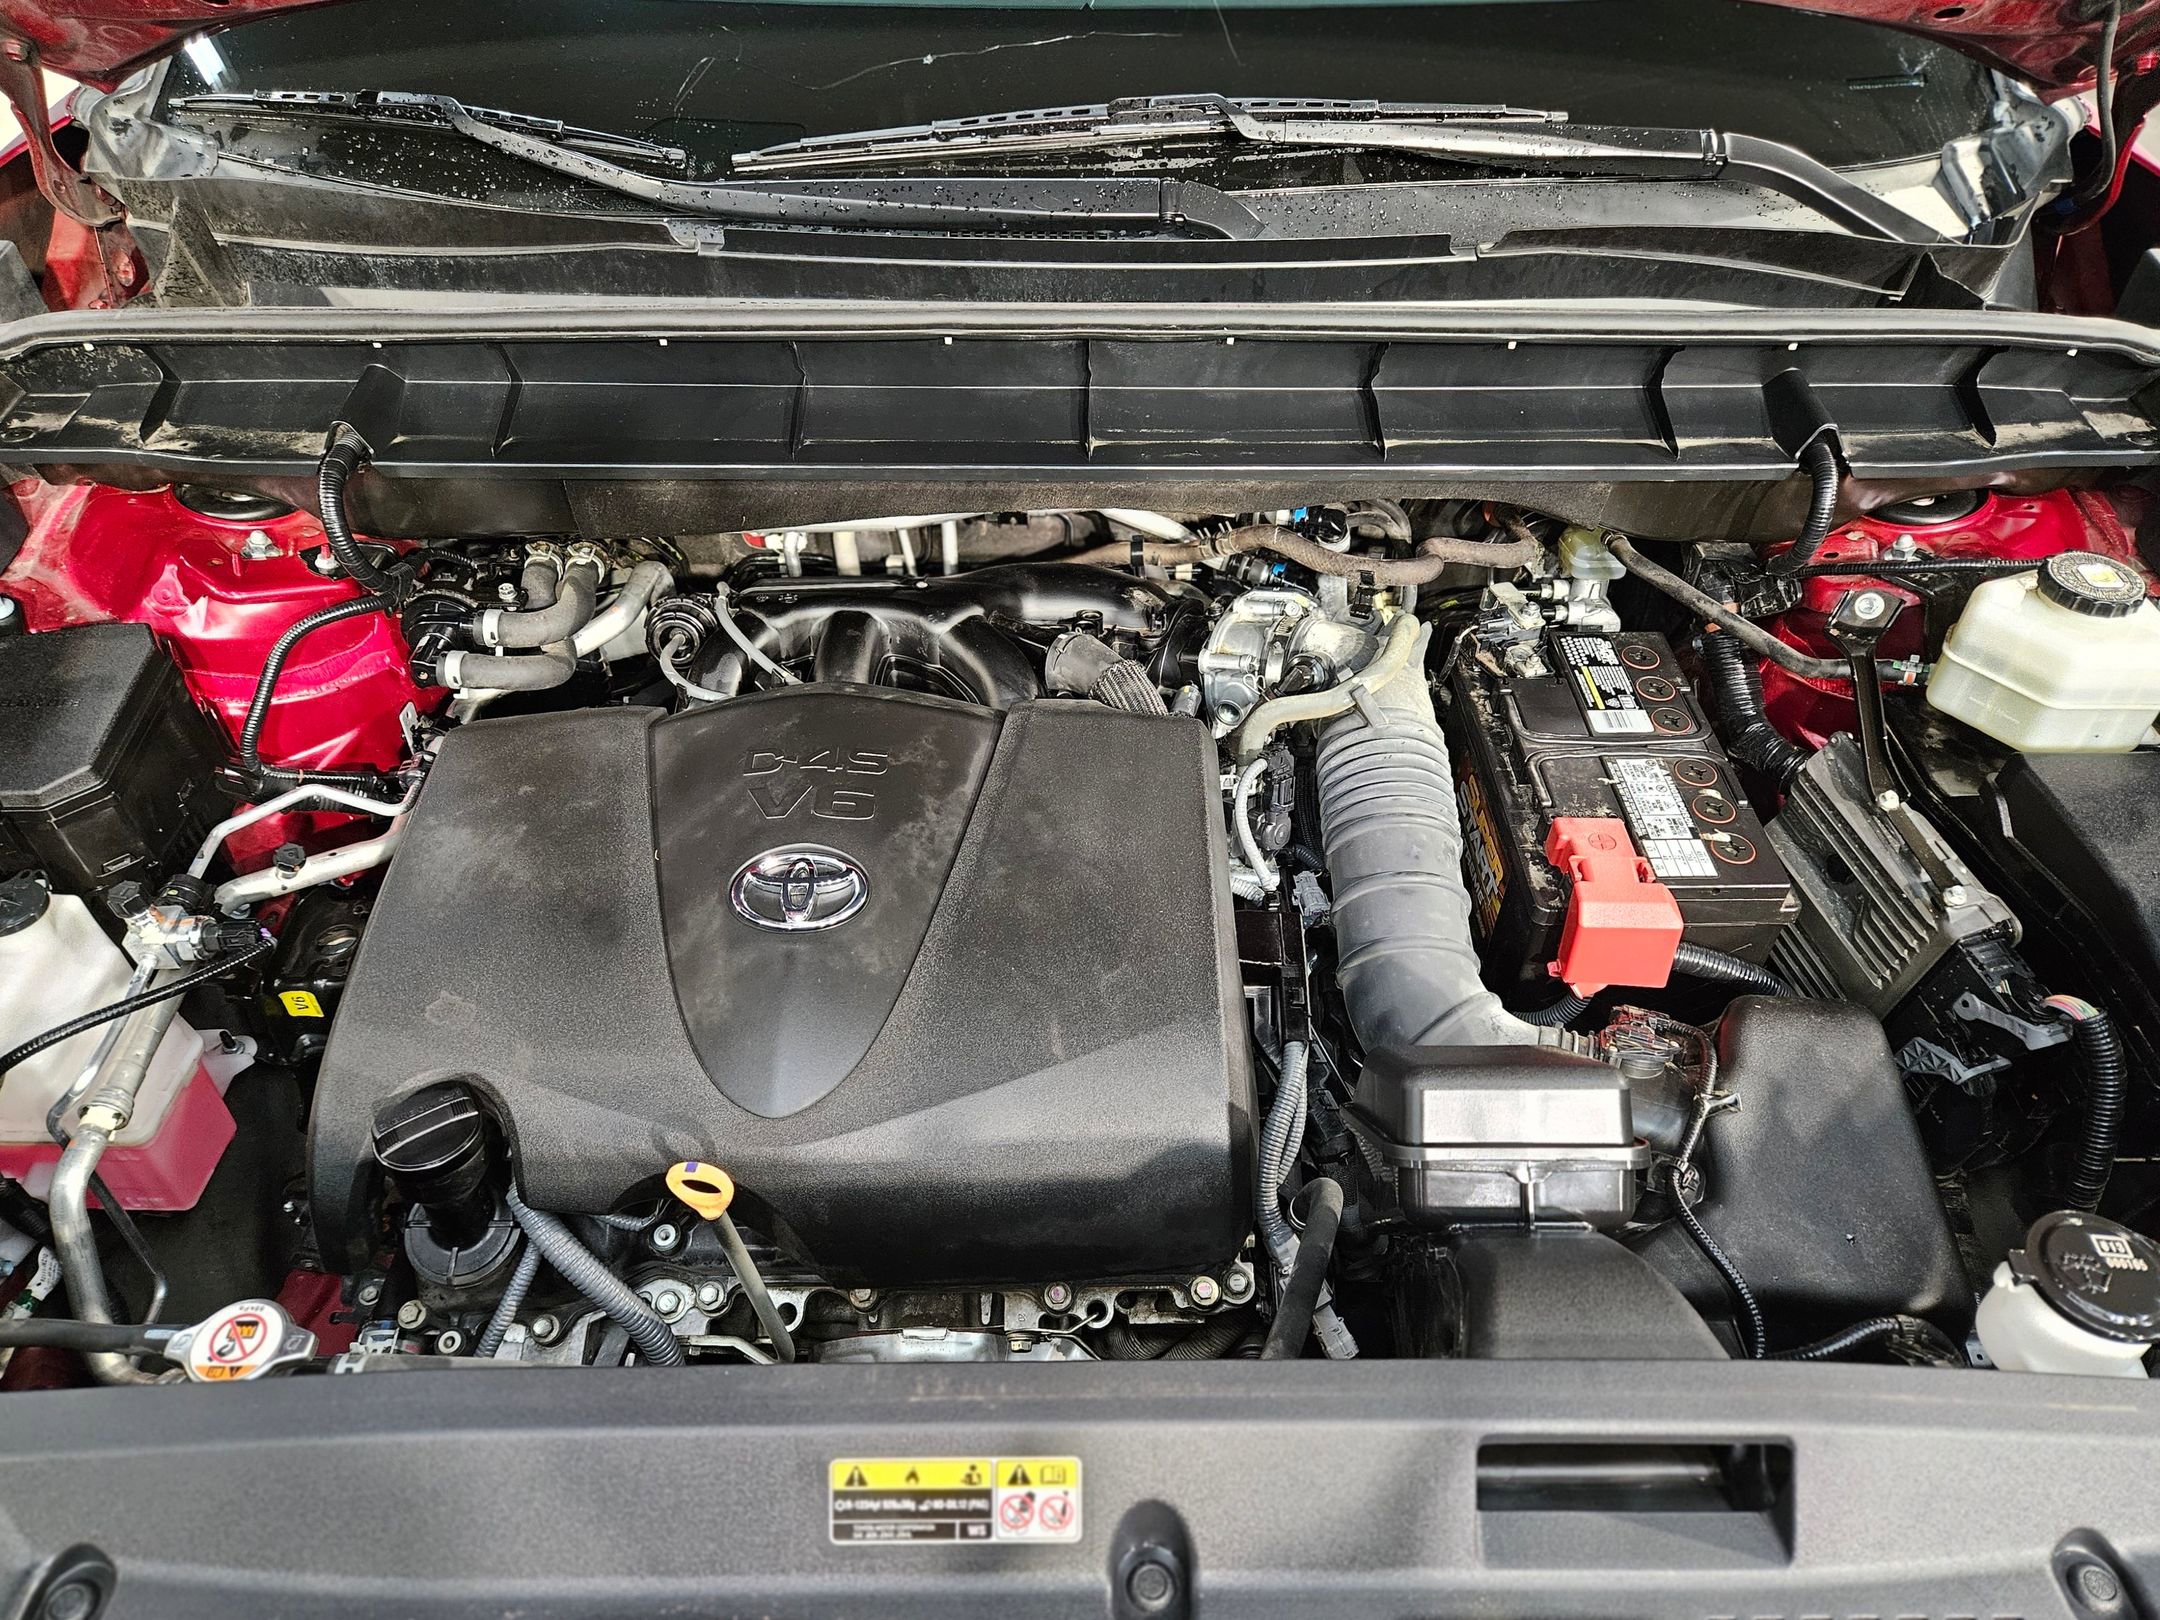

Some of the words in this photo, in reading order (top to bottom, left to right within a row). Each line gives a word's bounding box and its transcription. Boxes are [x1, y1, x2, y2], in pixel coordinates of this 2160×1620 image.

[743, 746, 889, 776] D-4S
[748, 785, 878, 821] V6
[1457, 781, 1498, 897] START
[1468, 774, 1504, 887] SUPER
[291, 996, 309, 1010] V6
